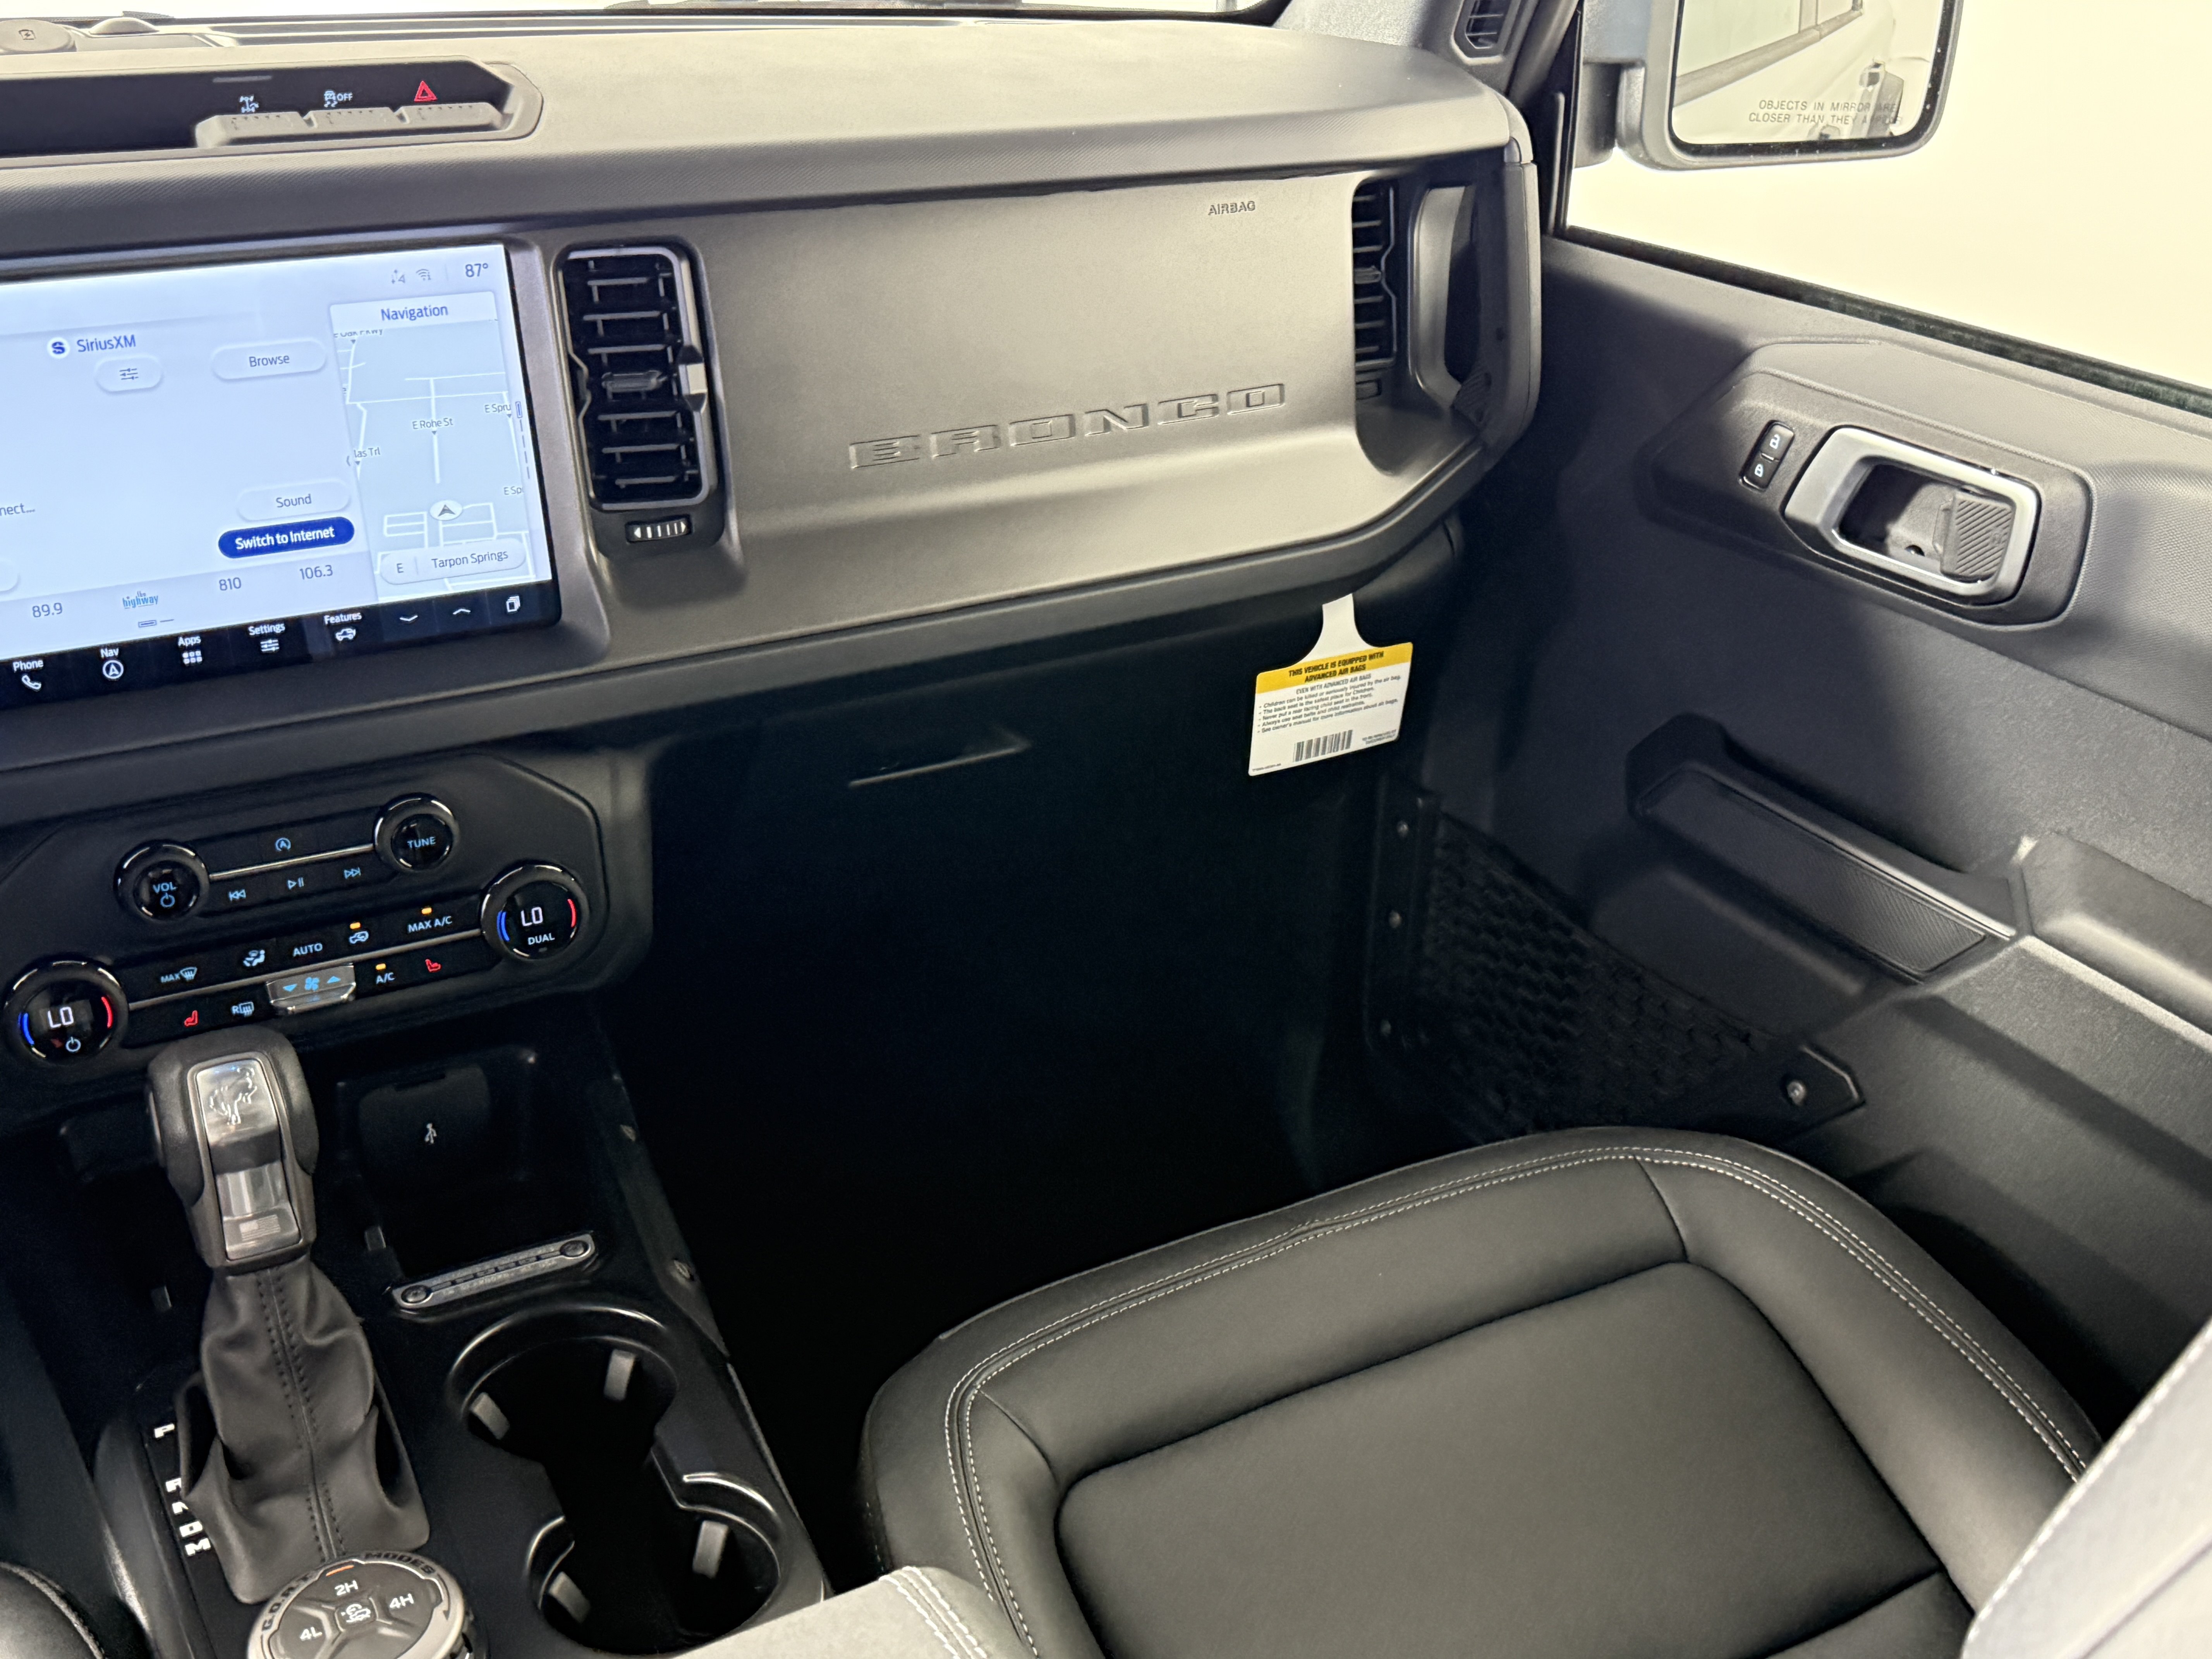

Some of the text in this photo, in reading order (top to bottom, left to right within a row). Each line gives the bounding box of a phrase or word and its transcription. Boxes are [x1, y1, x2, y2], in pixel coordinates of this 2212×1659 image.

[337, 93, 353, 101] OFF
[1759, 99, 1808, 112] OBJECTS
[1813, 101, 1824, 112] IN
[1830, 101, 1870, 113] MIRROR
[1749, 112, 1791, 124] CLOSER
[1796, 113, 1824, 124] THAN
[1830, 113, 1856, 125] THEY
[1208, 201, 1256, 215] AIRBAG
[381, 304, 448, 322] Navigation
[77, 334, 136, 353] SiriusXM
[249, 353, 290, 368] Browse
[484, 404, 491, 413] E
[412, 421, 419, 429] E
[443, 417, 453, 426] St
[849, 383, 1285, 470] BRONCO
[504, 487, 510, 495] E
[276, 494, 312, 508] Sound
[235, 527, 335, 550] Switch to Internet
[396, 549, 509, 574] E Tarpon Springs
[300, 565, 333, 580] 106.3
[218, 577, 242, 591] 810
[122, 595, 158, 608] highway
[32, 602, 63, 618] 89.9
[324, 610, 362, 625] Features
[248, 622, 285, 637] Settings
[178, 635, 201, 649] Apps
[100, 647, 119, 658] Nav
[12, 658, 44, 672] Phone
[1289, 668, 1303, 677] THIS
[1304, 663, 1329, 673] VEHICLE
[1338, 655, 1367, 667] EQUIPPED
[1368, 651, 1384, 660] WITH
[1305, 664, 1366, 682] ADVANCED AIR BAGS
[1323, 679, 1348, 689] ADVANCED
[1263, 700, 1285, 708] Children
[407, 836, 436, 849] TUNE
[153, 882, 177, 893] VOL
[408, 915, 453, 933] MAX A/C
[520, 906, 543, 927] LO
[527, 932, 555, 946] DUAL
[293, 943, 323, 957] AUTO
[161, 972, 180, 984] MAX
[376, 972, 395, 984] A/C
[48, 1006, 74, 1029] LO
[154, 1422, 175, 1439] P
[179, 1520, 203, 1537] D
[185, 1537, 211, 1556] M
[364, 1552, 436, 1575] MODES
[335, 1580, 358, 1596] 2H
[389, 1594, 414, 1609] 4H
[299, 1626, 323, 1641] 4L
